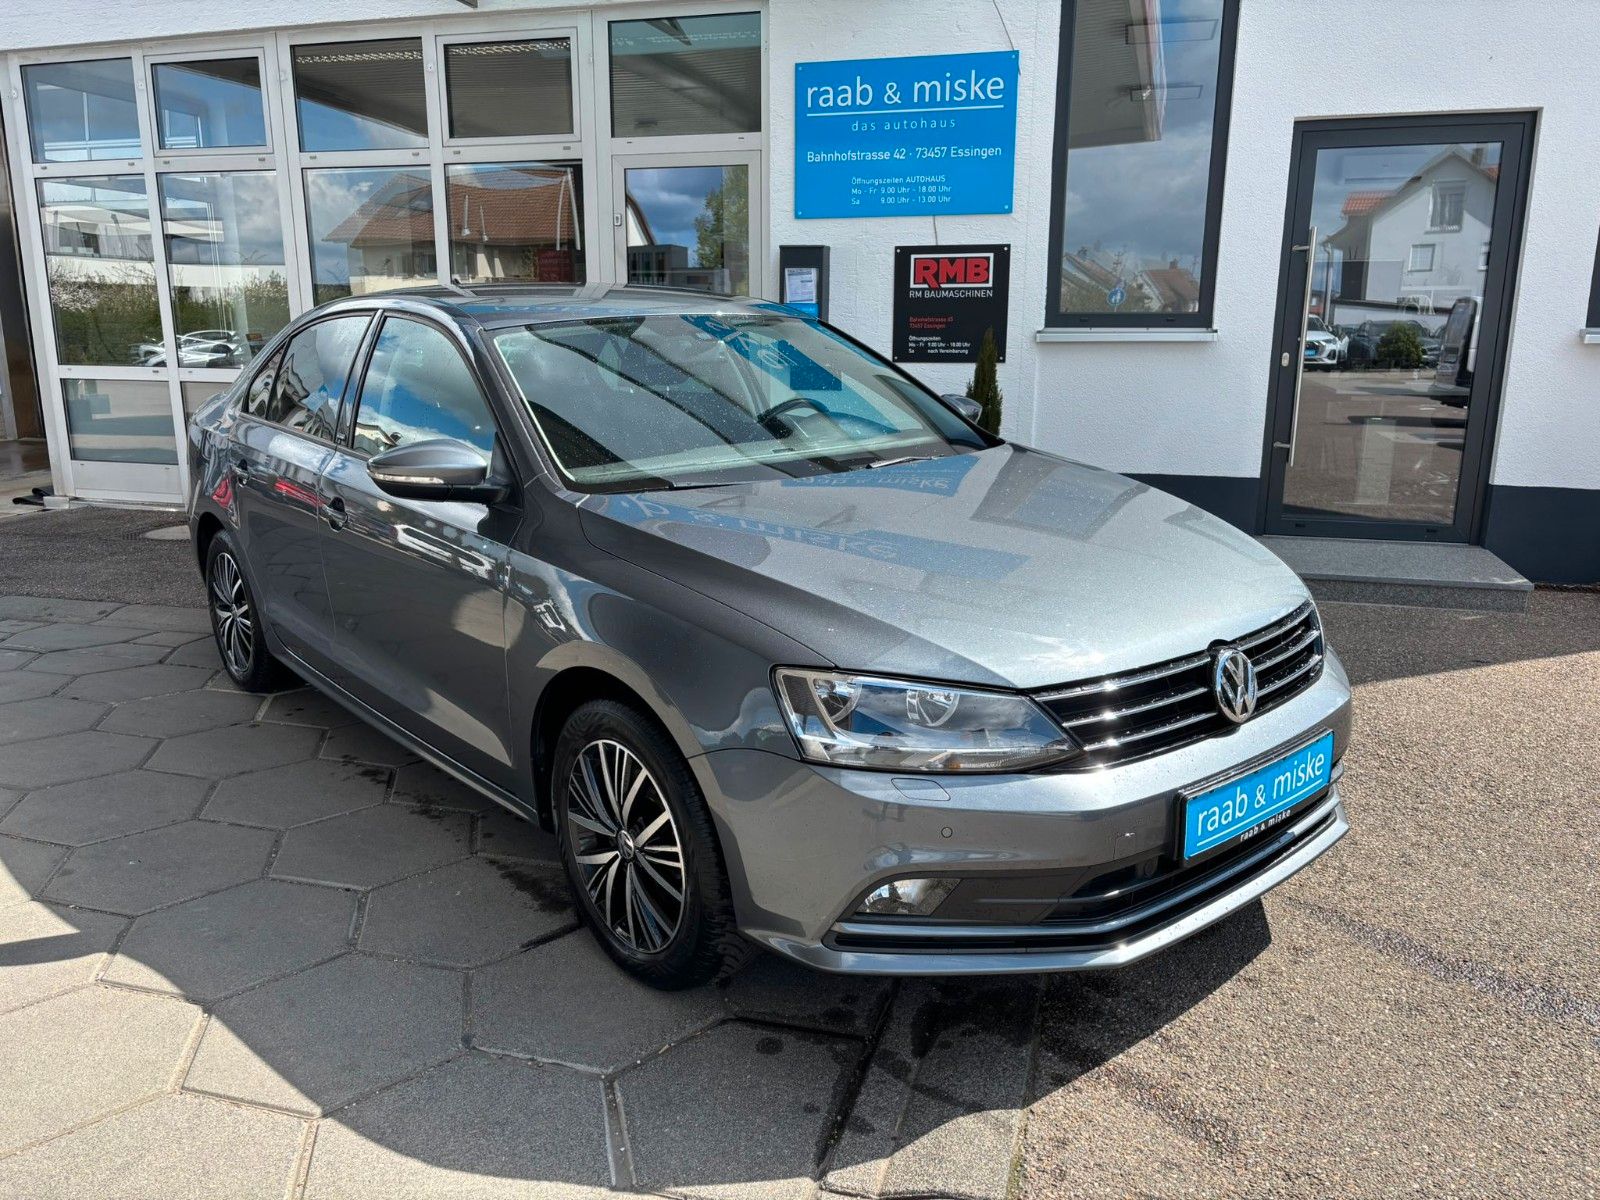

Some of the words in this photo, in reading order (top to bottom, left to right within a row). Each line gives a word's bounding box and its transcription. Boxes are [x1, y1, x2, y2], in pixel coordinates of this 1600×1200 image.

[807, 76, 873, 108] raab
[884, 82, 902, 105] &
[913, 69, 1005, 103] miske
[851, 120, 876, 132] das
[884, 117, 956, 131] autohaus
[807, 149, 891, 163] Bahnhofstrasse
[893, 148, 906, 160] 42
[916, 146, 947, 159] 73457
[951, 145, 1002, 160] Essingen
[851, 176, 904, 186] Öffnungszeiten
[905, 174, 946, 184] AUTOHAUS
[851, 188, 862, 196] Mo
[880, 186, 896, 194] 9.00
[897, 186, 910, 194] Uhr
[938, 184, 952, 193] Uhr
[897, 196, 910, 204] Uhr
[938, 194, 952, 203] Uhr
[914, 256, 989, 289] RMB
[909, 290, 922, 298] RM
[924, 289, 993, 298] BAUMASCHINEN
[1197, 786, 1248, 837] raab
[1254, 784, 1266, 809] &
[1273, 752, 1325, 800] miske
[1240, 824, 1259, 842] raab
[1268, 810, 1292, 826] miske
